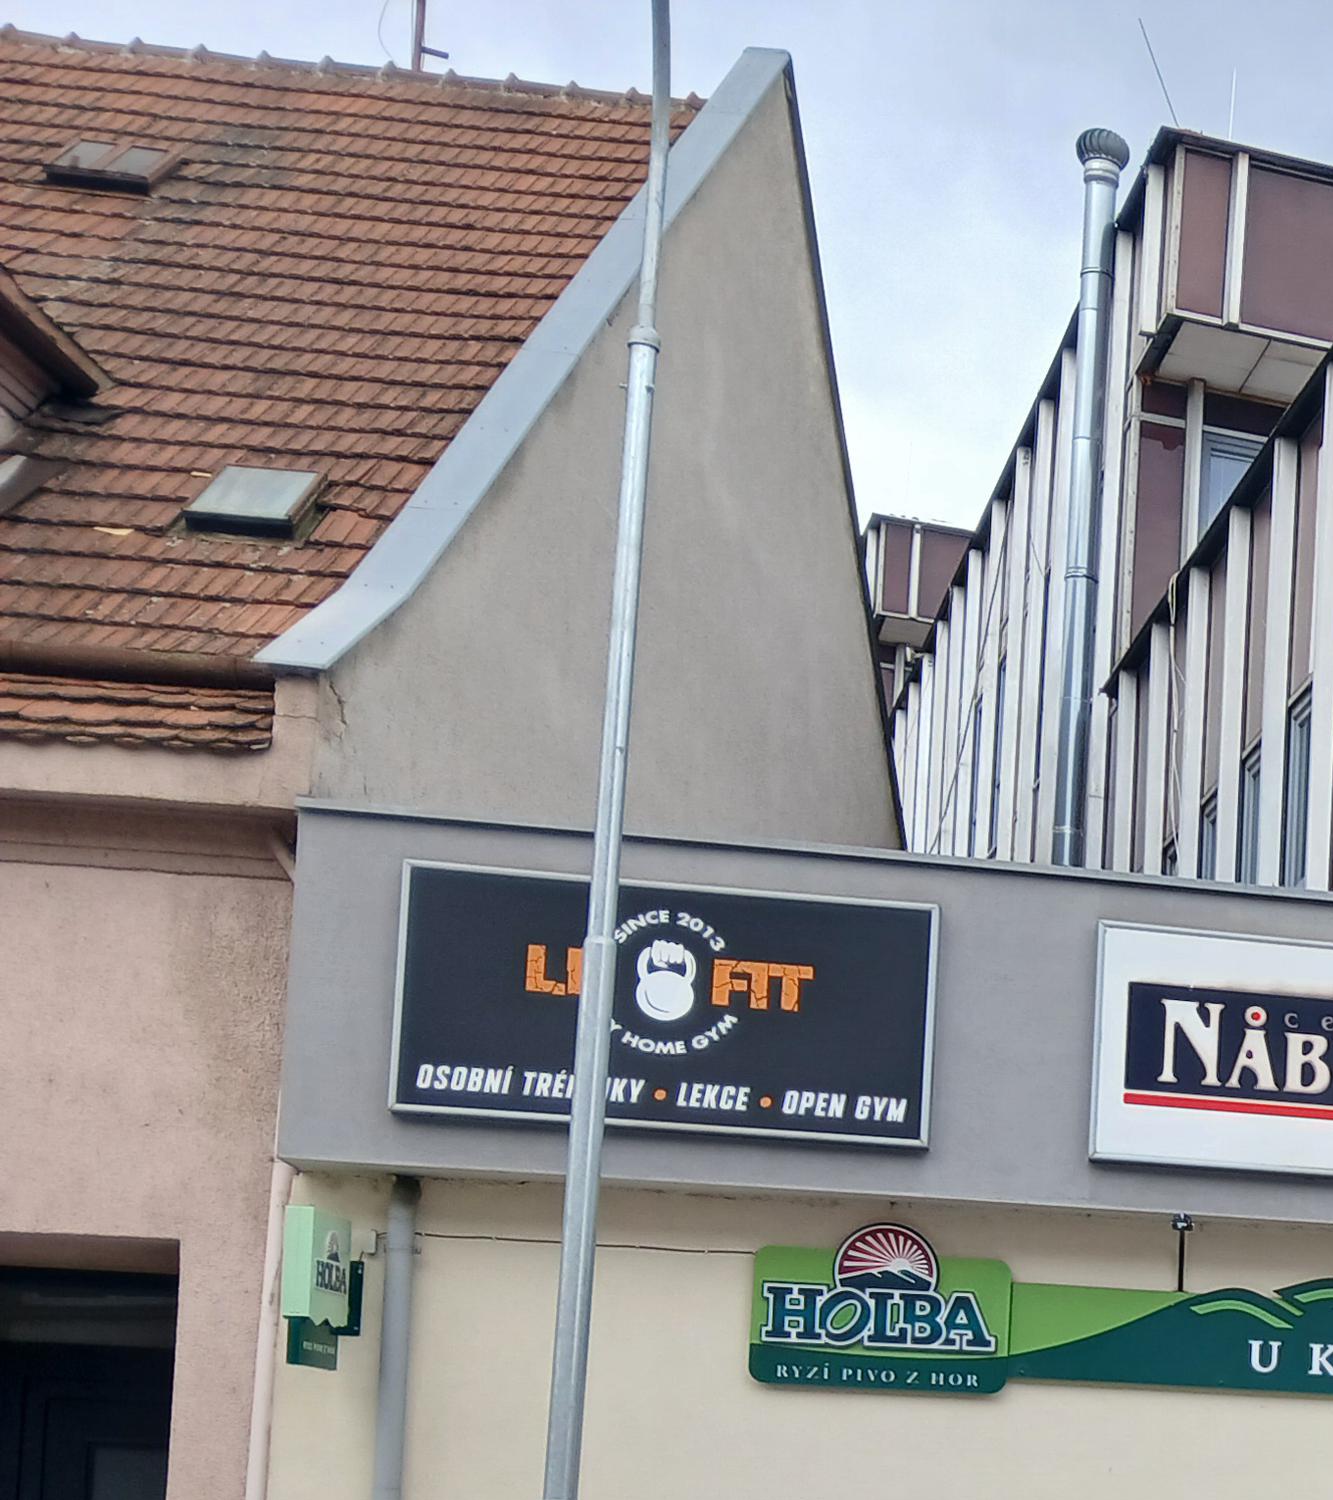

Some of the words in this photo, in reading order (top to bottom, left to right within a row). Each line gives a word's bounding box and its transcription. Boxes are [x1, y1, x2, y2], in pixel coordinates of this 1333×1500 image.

[614, 910, 670, 944] SINCE
[676, 912, 726, 951] 2013
[712, 958, 814, 1013] FIT
[621, 1031, 687, 1055] HOME
[691, 1014, 738, 1049] GYM
[416, 1064, 514, 1095] OSOBNÍ
[522, 1069, 646, 1103] TRÉKY
[676, 1082, 751, 1112] LEKCE
[782, 1090, 847, 1118] OPEN
[854, 1095, 908, 1123] GYM
[315, 1260, 348, 1295] HOLBA
[761, 1282, 997, 1352] HOLBA
[1248, 1339, 1282, 1373] U
[842, 1367, 896, 1383] PIVO
[906, 1371, 920, 1384] Z
[931, 1372, 979, 1387] HOR
